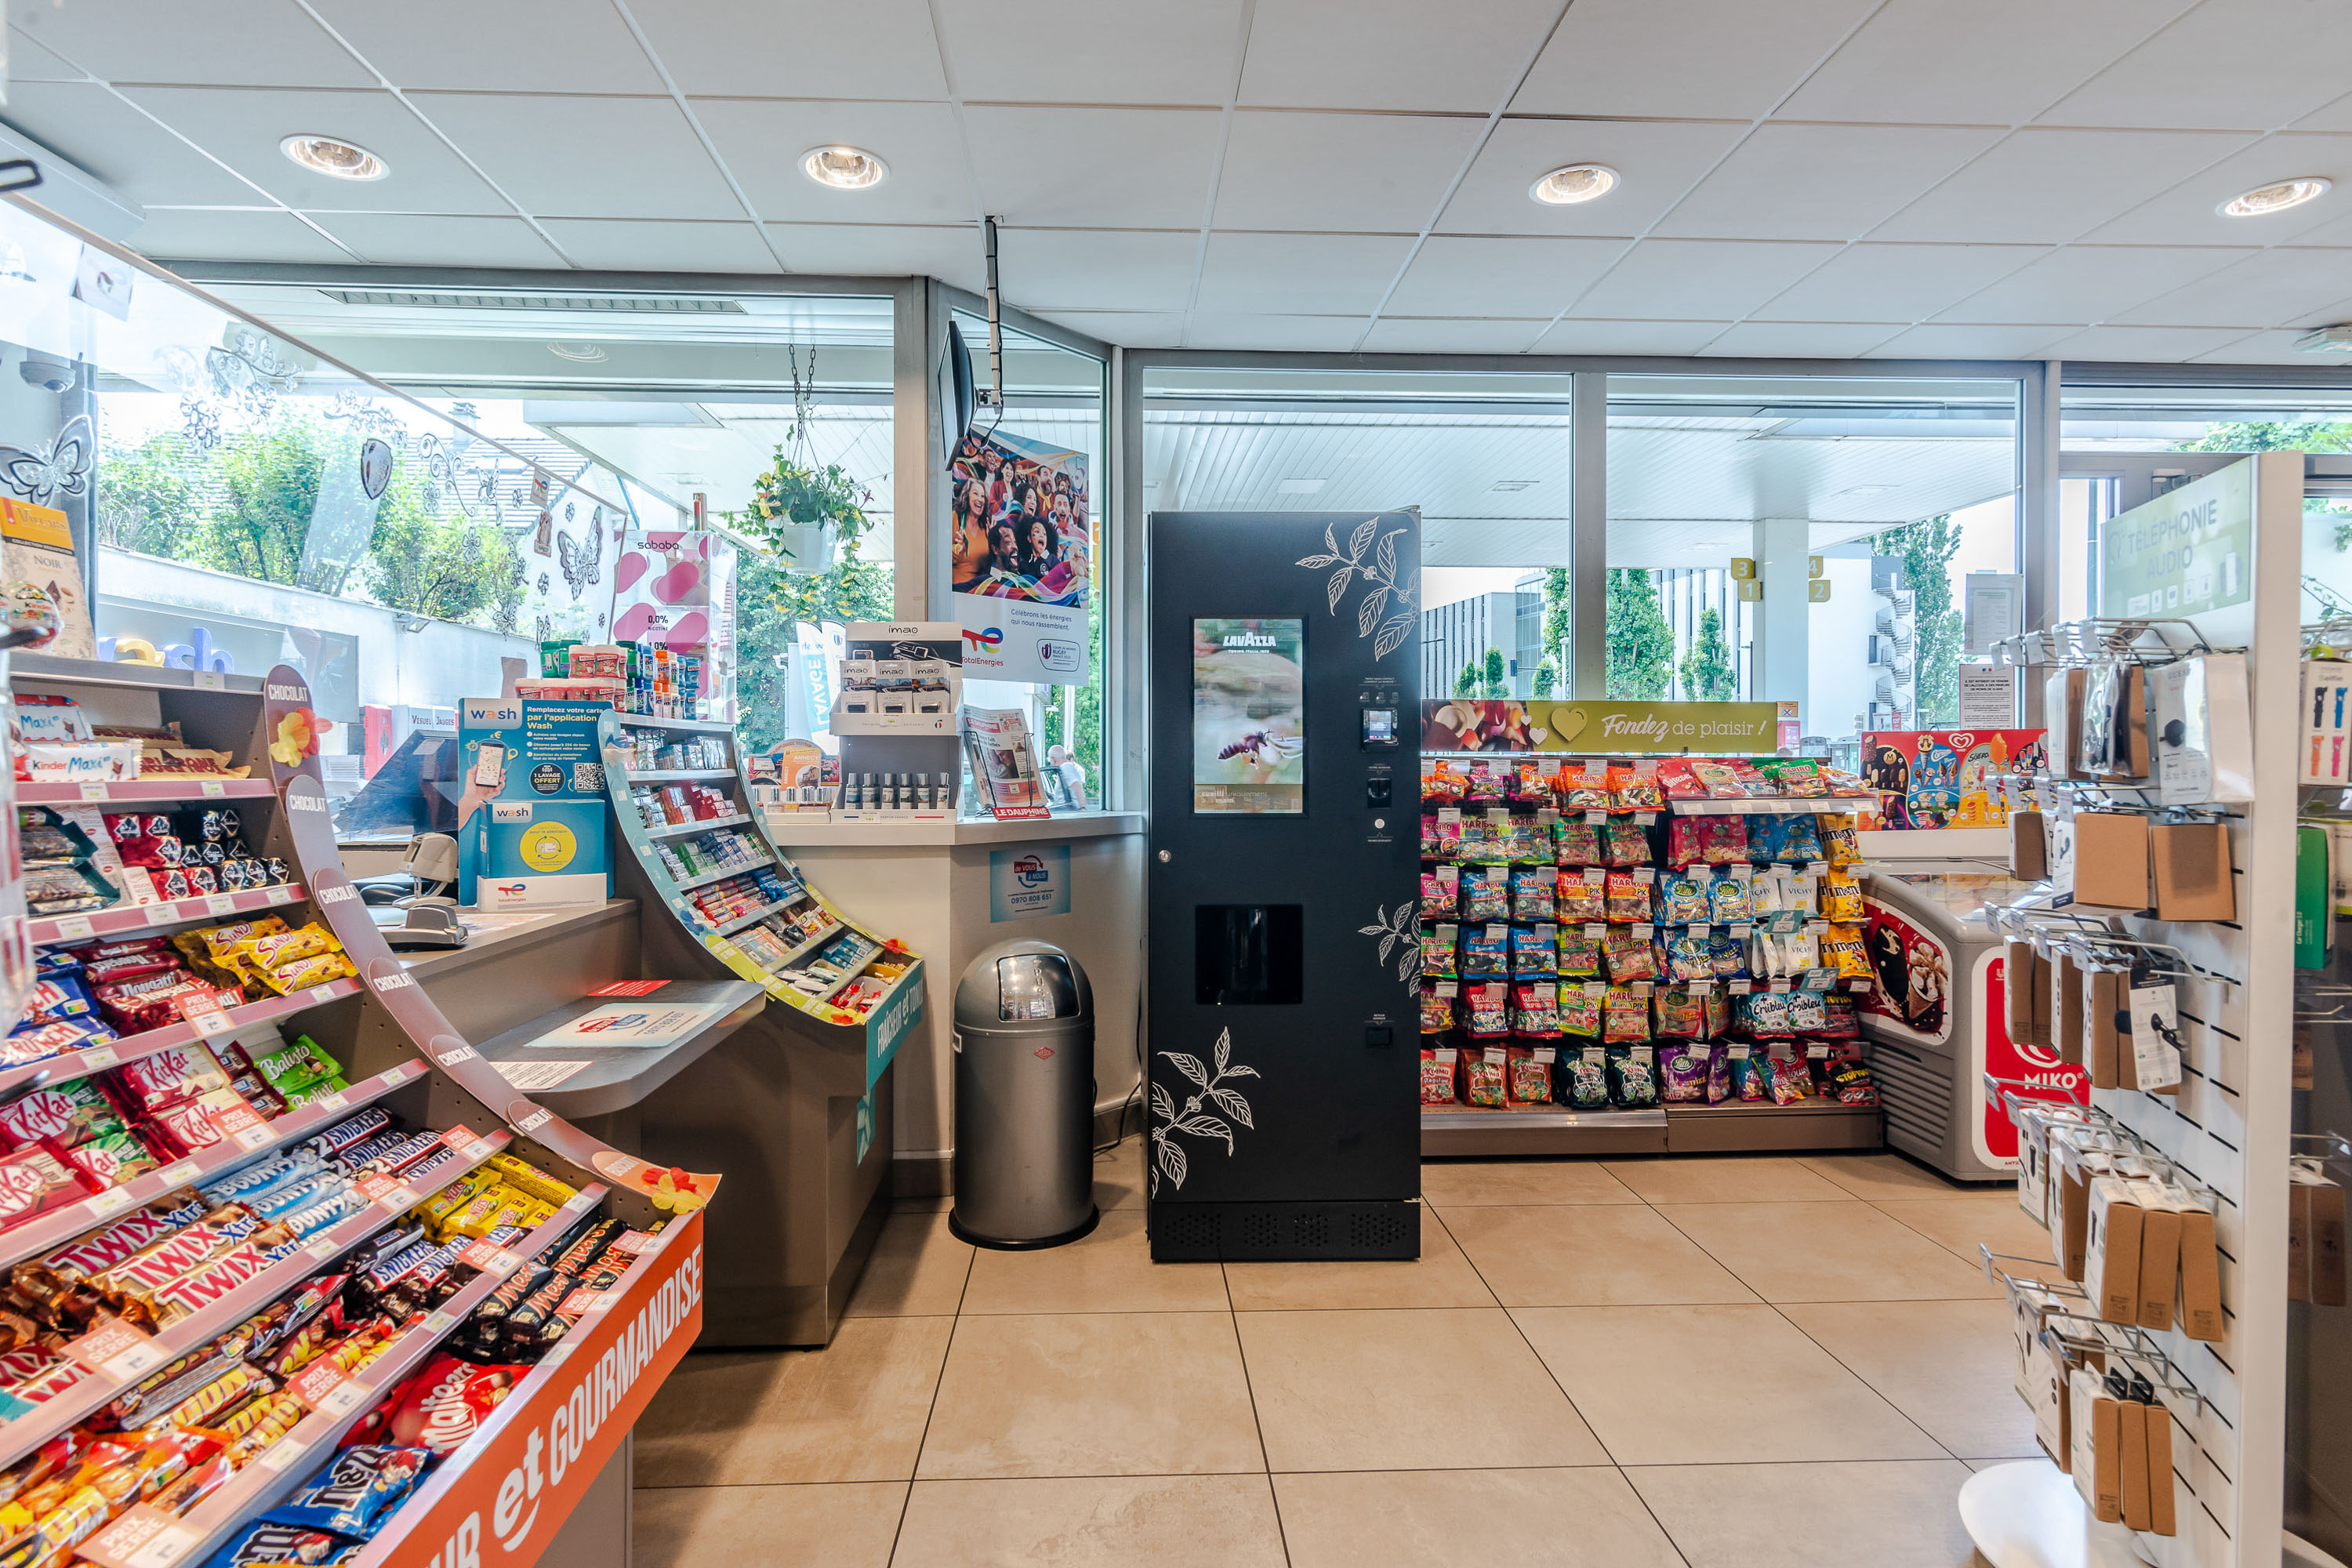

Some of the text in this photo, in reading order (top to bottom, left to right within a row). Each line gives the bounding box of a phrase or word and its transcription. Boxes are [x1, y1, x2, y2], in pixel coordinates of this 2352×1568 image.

[34, 555, 61, 568] NOIR
[1738, 562, 1748, 577] 3
[2148, 545, 2193, 578] AUDIO
[1746, 584, 1752, 597] 1
[1815, 584, 1824, 597] 2
[1011, 609, 1039, 618] Célébrons
[1050, 614, 1072, 622] énergies
[1223, 632, 1276, 646] LAVAZZA
[962, 656, 1004, 666] TotalEnergies
[267, 684, 307, 703] CHOCOLAT
[21, 715, 53, 731] Maxi
[436, 716, 455, 726] JAUGES
[471, 708, 516, 720] wash
[1601, 713, 1766, 742] Fondez de plaisir !
[68, 757, 103, 774] Maxi
[289, 795, 326, 812] CHOCOLAT
[497, 808, 528, 817] wash
[318, 884, 358, 905] CHOCOLAT
[1474, 881, 1501, 890] HARIBO
[373, 973, 413, 993] CHOCOLAT
[183, 993, 210, 1005] PRIX
[877, 1001, 902, 1058] FRAÎCHEUR
[902, 989, 909, 1018] et
[260, 1046, 310, 1080] Balisto
[437, 1047, 477, 1066] CHOCOLAT
[146, 1051, 189, 1090] KitKat
[2024, 1073, 2077, 1090] MIKO
[13, 1091, 74, 1142] KitKat
[220, 1108, 245, 1123] PRIX
[519, 1109, 554, 1131] CHOCOLAT
[326, 1108, 388, 1145] SNICKERS
[446, 1130, 465, 1142] PRIX
[347, 1132, 405, 1169] SNICKERS
[383, 1131, 441, 1164] SNICKERS
[214, 1158, 296, 1196] BOUNTY
[363, 1178, 383, 1190] PRIX
[257, 1178, 319, 1213] OUNTY
[443, 1181, 466, 1206] NUTS
[472, 1197, 491, 1221] NUTS
[43, 1209, 165, 1276] TWIX
[106, 1221, 224, 1290] TWIX
[379, 1240, 437, 1287] SNICKERS
[154, 1241, 270, 1312] TWIX
[494, 1243, 701, 1539] et GOURMANDISE
